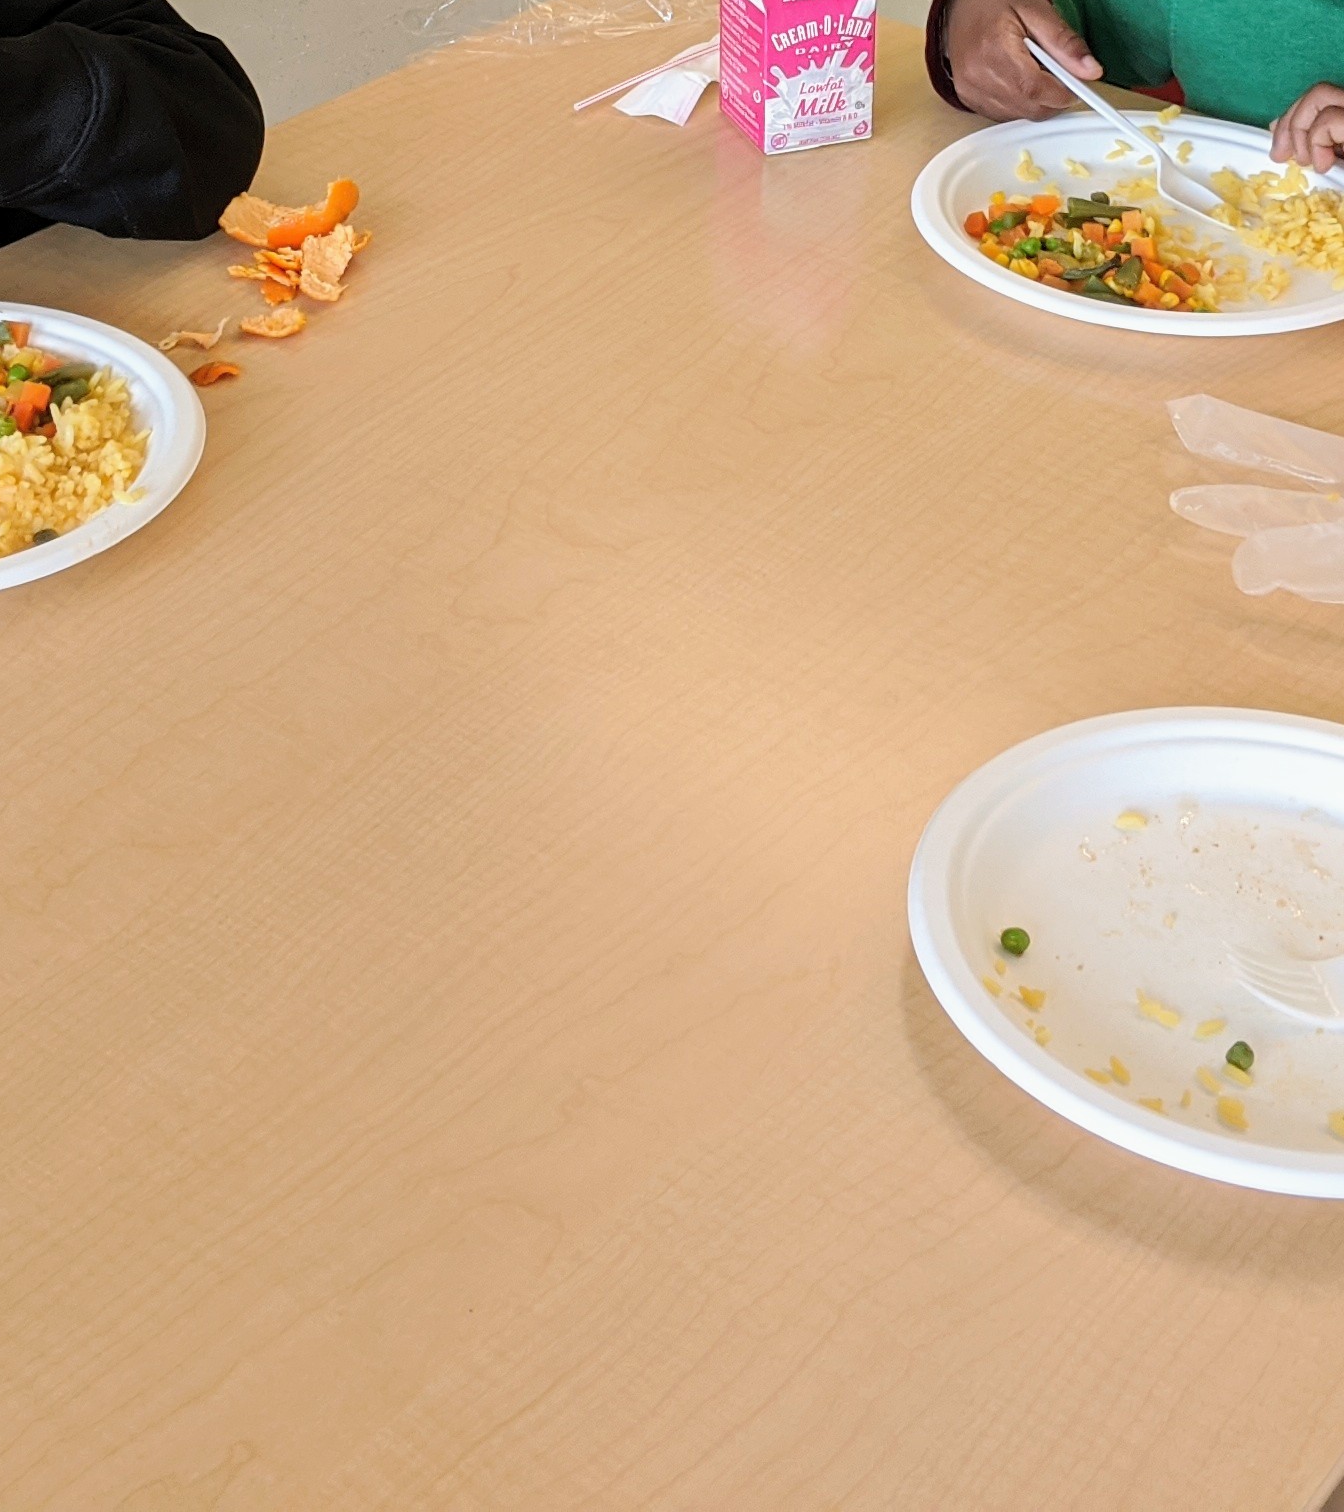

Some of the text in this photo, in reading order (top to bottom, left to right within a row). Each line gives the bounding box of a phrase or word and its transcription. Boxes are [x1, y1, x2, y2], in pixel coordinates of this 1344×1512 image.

[795, 40, 855, 55] DAIRY
[799, 76, 844, 95] Lowfat
[793, 90, 847, 120] Milk
